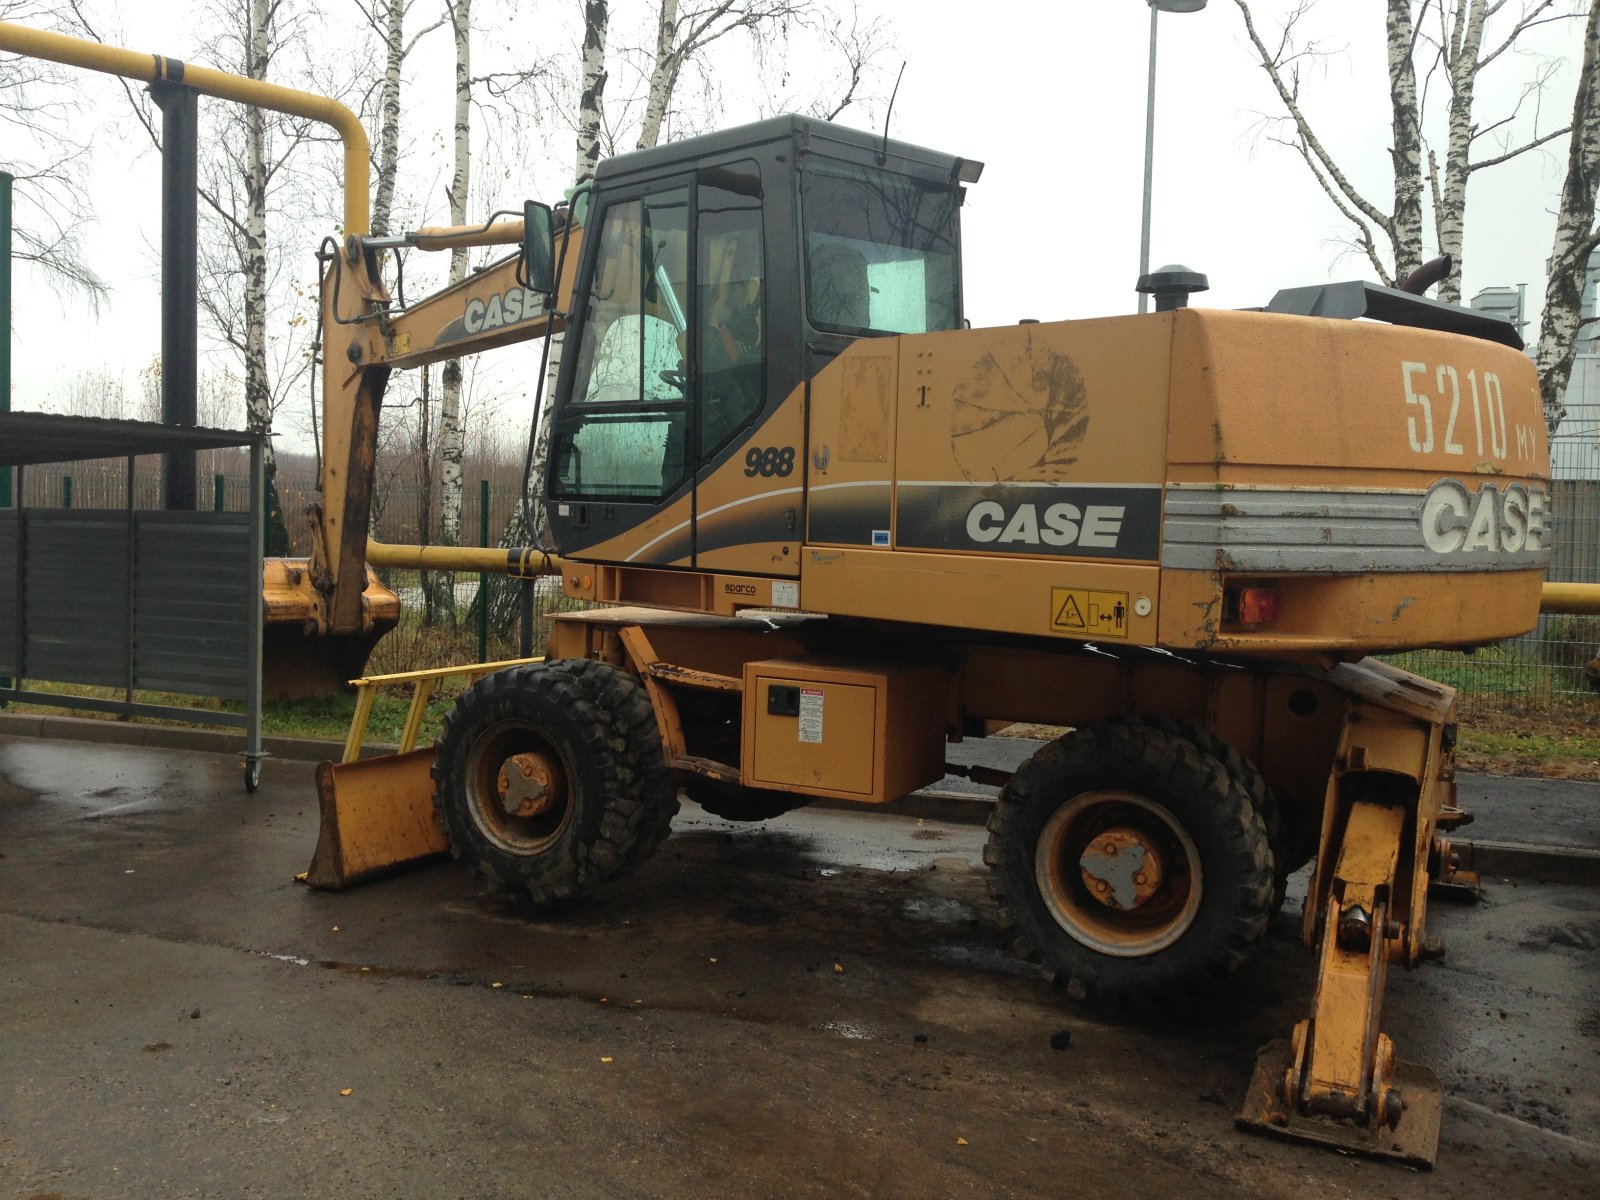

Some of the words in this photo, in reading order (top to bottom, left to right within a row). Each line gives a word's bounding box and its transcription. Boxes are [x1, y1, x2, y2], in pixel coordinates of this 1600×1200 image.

[464, 288, 544, 334] CASE
[1401, 361, 1507, 460] 5210
[744, 446, 796, 477] 988
[966, 501, 1126, 548] CASE
[1422, 483, 1550, 554] CASE
[725, 583, 757, 594] sparco
